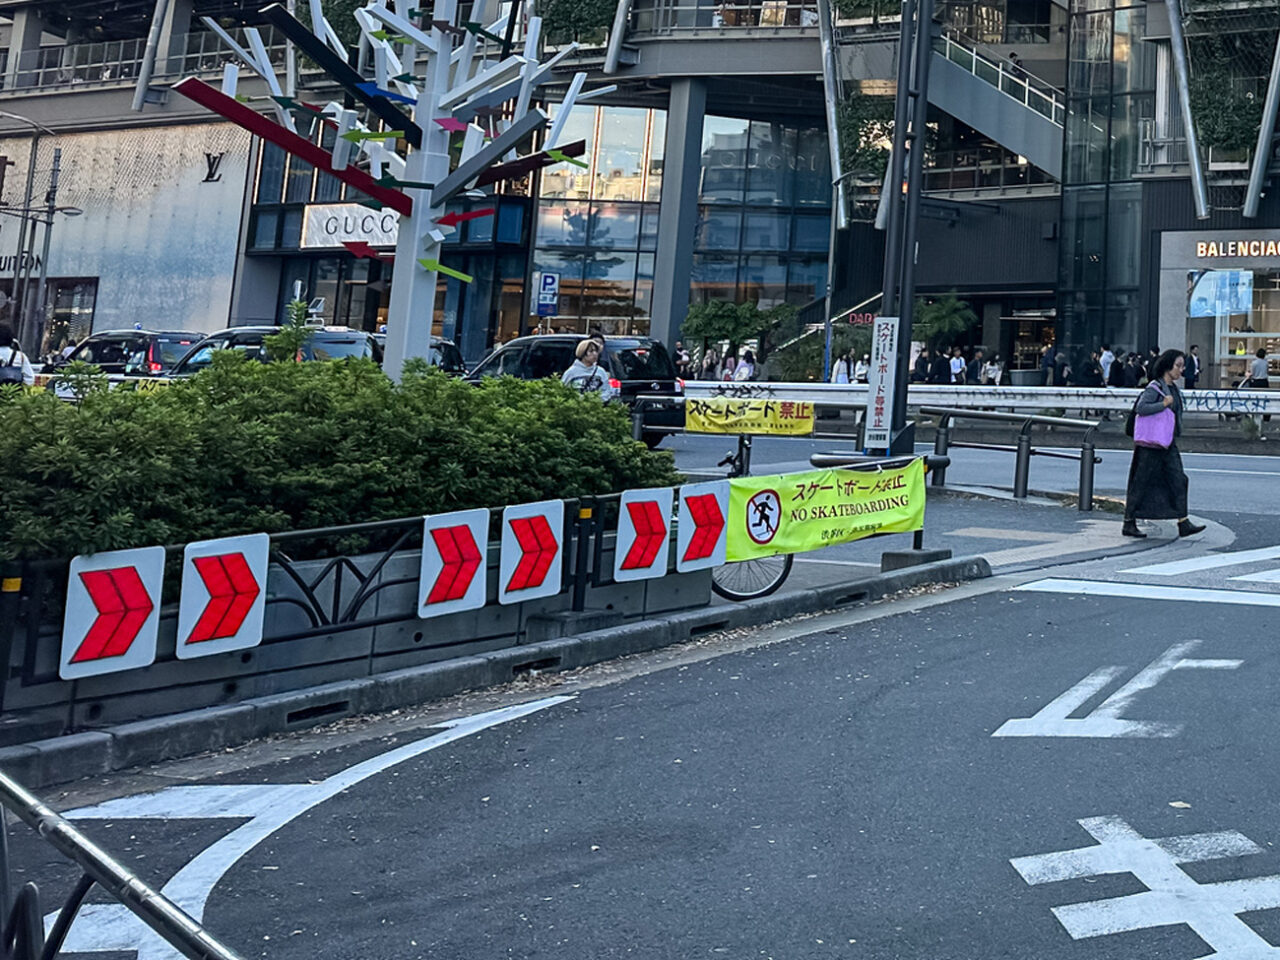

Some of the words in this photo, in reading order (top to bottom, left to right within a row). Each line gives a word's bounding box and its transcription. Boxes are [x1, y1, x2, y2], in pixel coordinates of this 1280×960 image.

[325, 214, 400, 235] GUCC
[542, 275, 556, 291] P
[790, 508, 807, 522] NO
[811, 494, 909, 520] SKATEBOARDING
